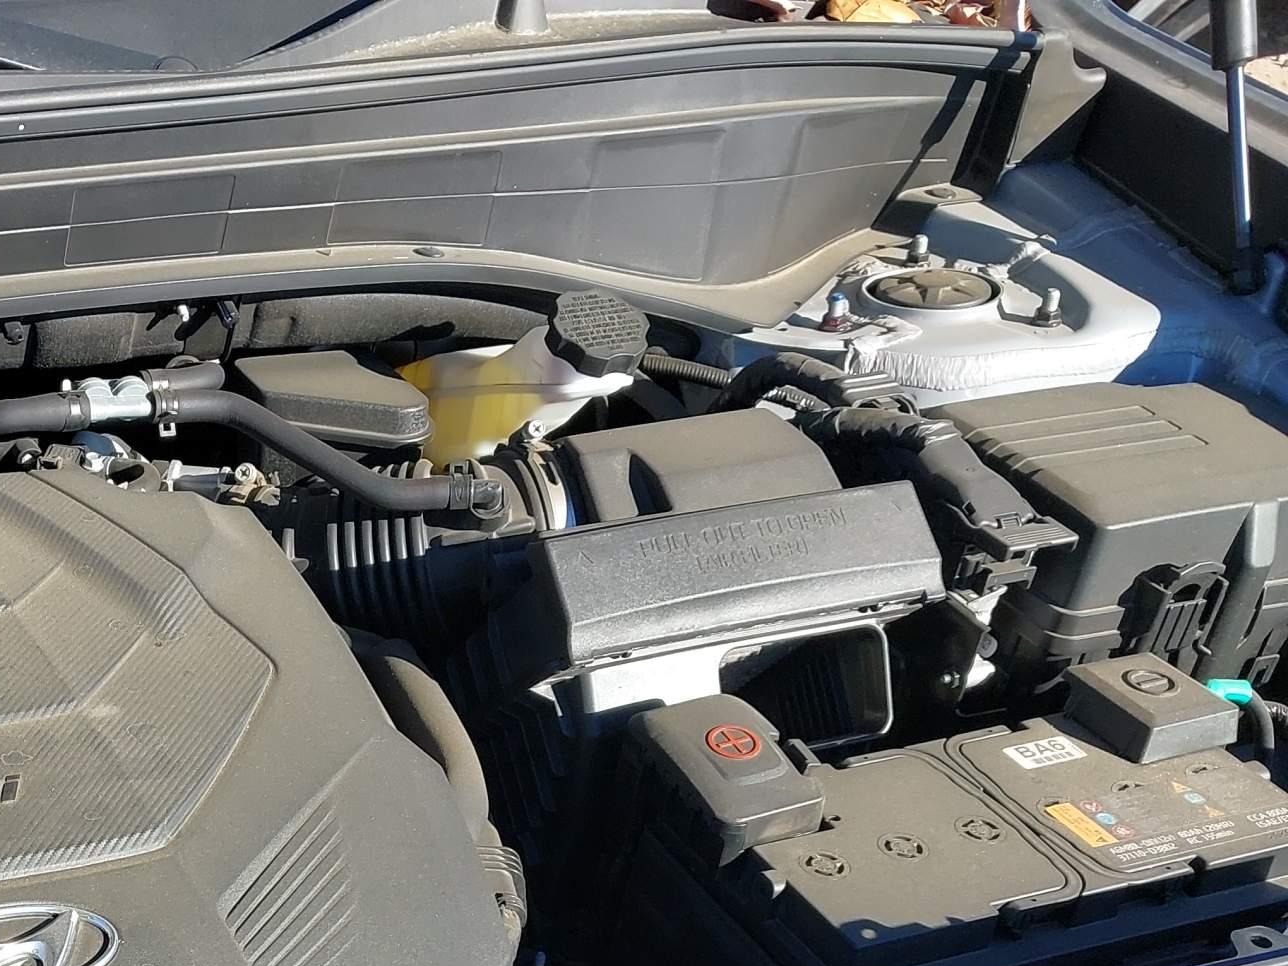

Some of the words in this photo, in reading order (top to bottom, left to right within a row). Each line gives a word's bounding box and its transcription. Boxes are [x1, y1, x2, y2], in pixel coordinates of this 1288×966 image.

[637, 532, 691, 557] PULL
[701, 521, 746, 546] OUT
[751, 516, 783, 537] TO
[785, 506, 847, 532] OPEN
[1014, 739, 1067, 759] BA6
